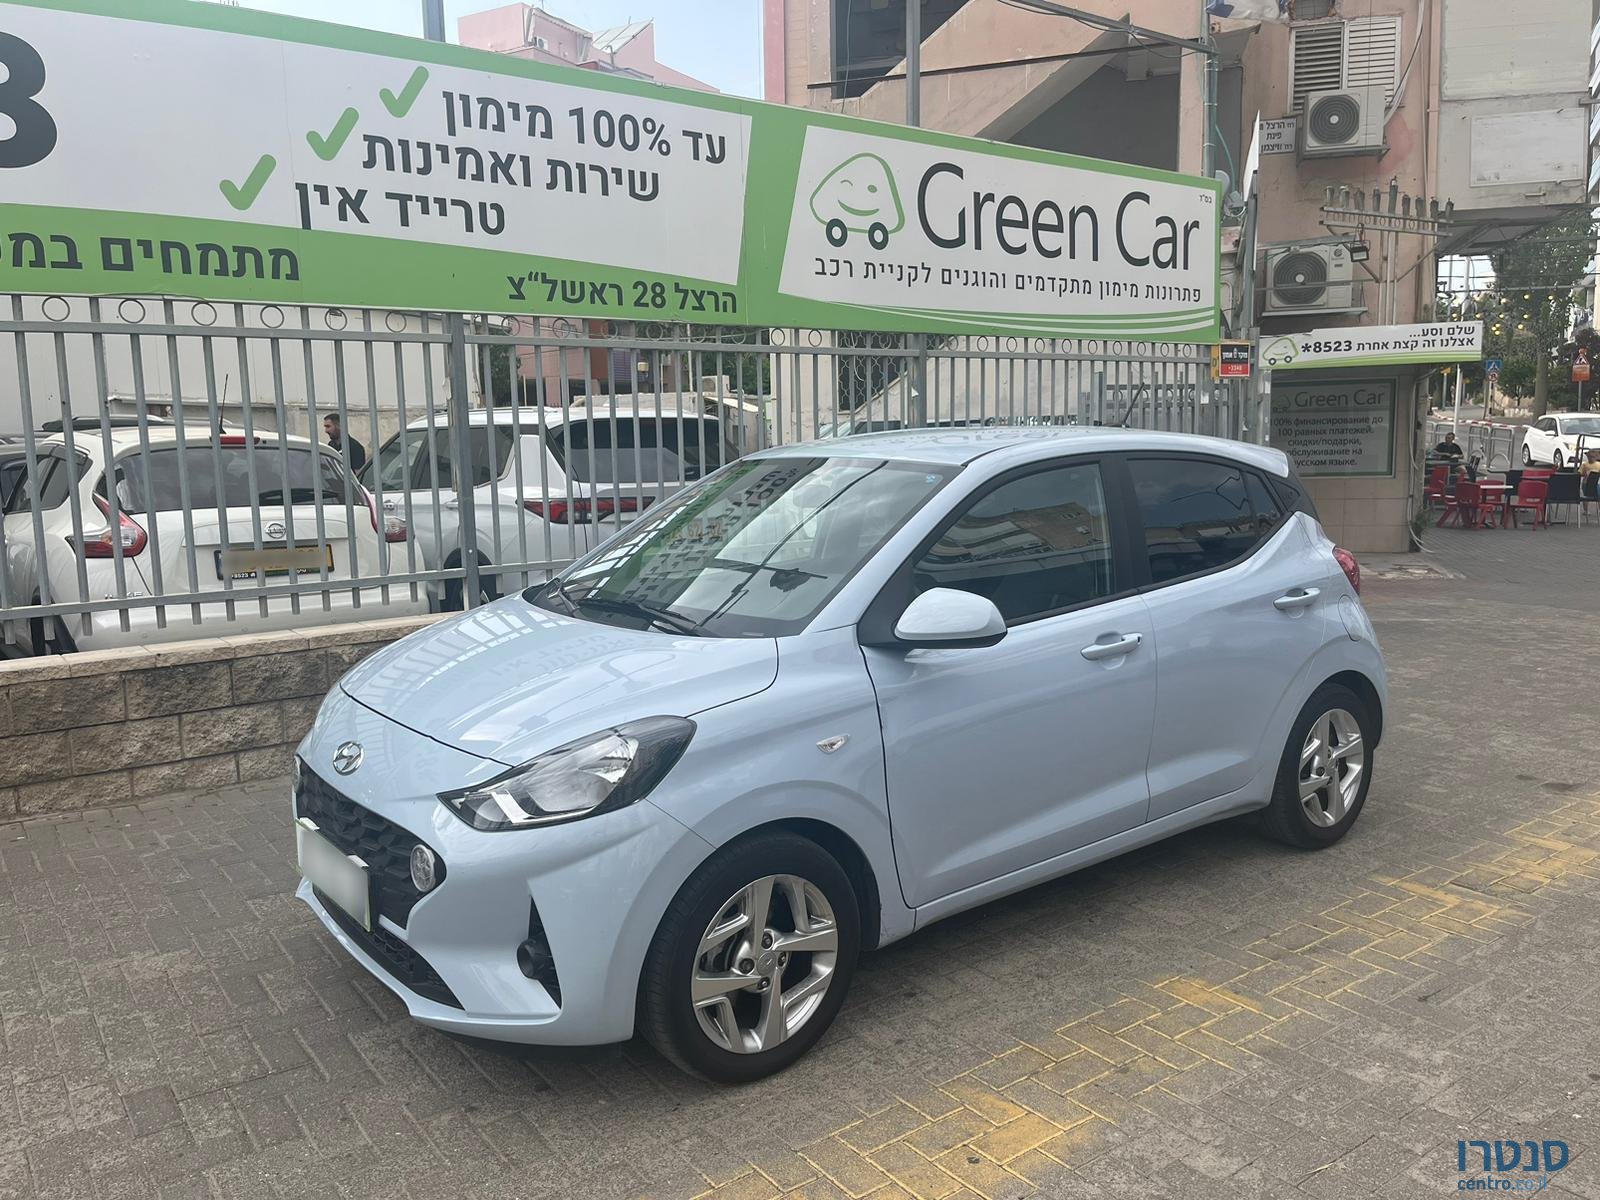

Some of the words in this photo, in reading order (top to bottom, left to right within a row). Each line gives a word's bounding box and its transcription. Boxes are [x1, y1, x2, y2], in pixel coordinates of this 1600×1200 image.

[442, 90, 554, 140] מימון
[1266, 121, 1285, 130] הרצל
[568, 106, 672, 157] 100%
[682, 128, 727, 165] עד
[362, 133, 532, 188] ואמינות
[545, 158, 660, 202] שירות
[295, 181, 370, 231] אין
[385, 191, 506, 236] טרייד
[917, 161, 1100, 262] Green
[1115, 190, 1201, 271] Car
[0, 231, 84, 270] במ
[100, 236, 300, 282] מתמחים
[814, 256, 854, 279] רכב
[863, 260, 932, 288] לקניית
[941, 267, 1007, 290] והוגנים
[632, 280, 666, 309] 28
[1015, 273, 1093, 296] מתקדמים
[1099, 280, 1139, 301] מימון
[1145, 284, 1202, 304] פתרונות
[674, 282, 738, 314] הרצל
[1440, 336, 1475, 348] אצלנו
[1447, 325, 1475, 337] שלם
[1356, 341, 1390, 351] אחרת
[1393, 339, 1419, 351] קצת
[1422, 338, 1436, 348] זה
[1294, 391, 1348, 408] Green
[1354, 388, 1385, 406] Car
[1278, 428, 1292, 437] 100
[1295, 429, 1327, 438] равных
[1294, 416, 1370, 427] финансирование
[1371, 416, 1384, 425] до
